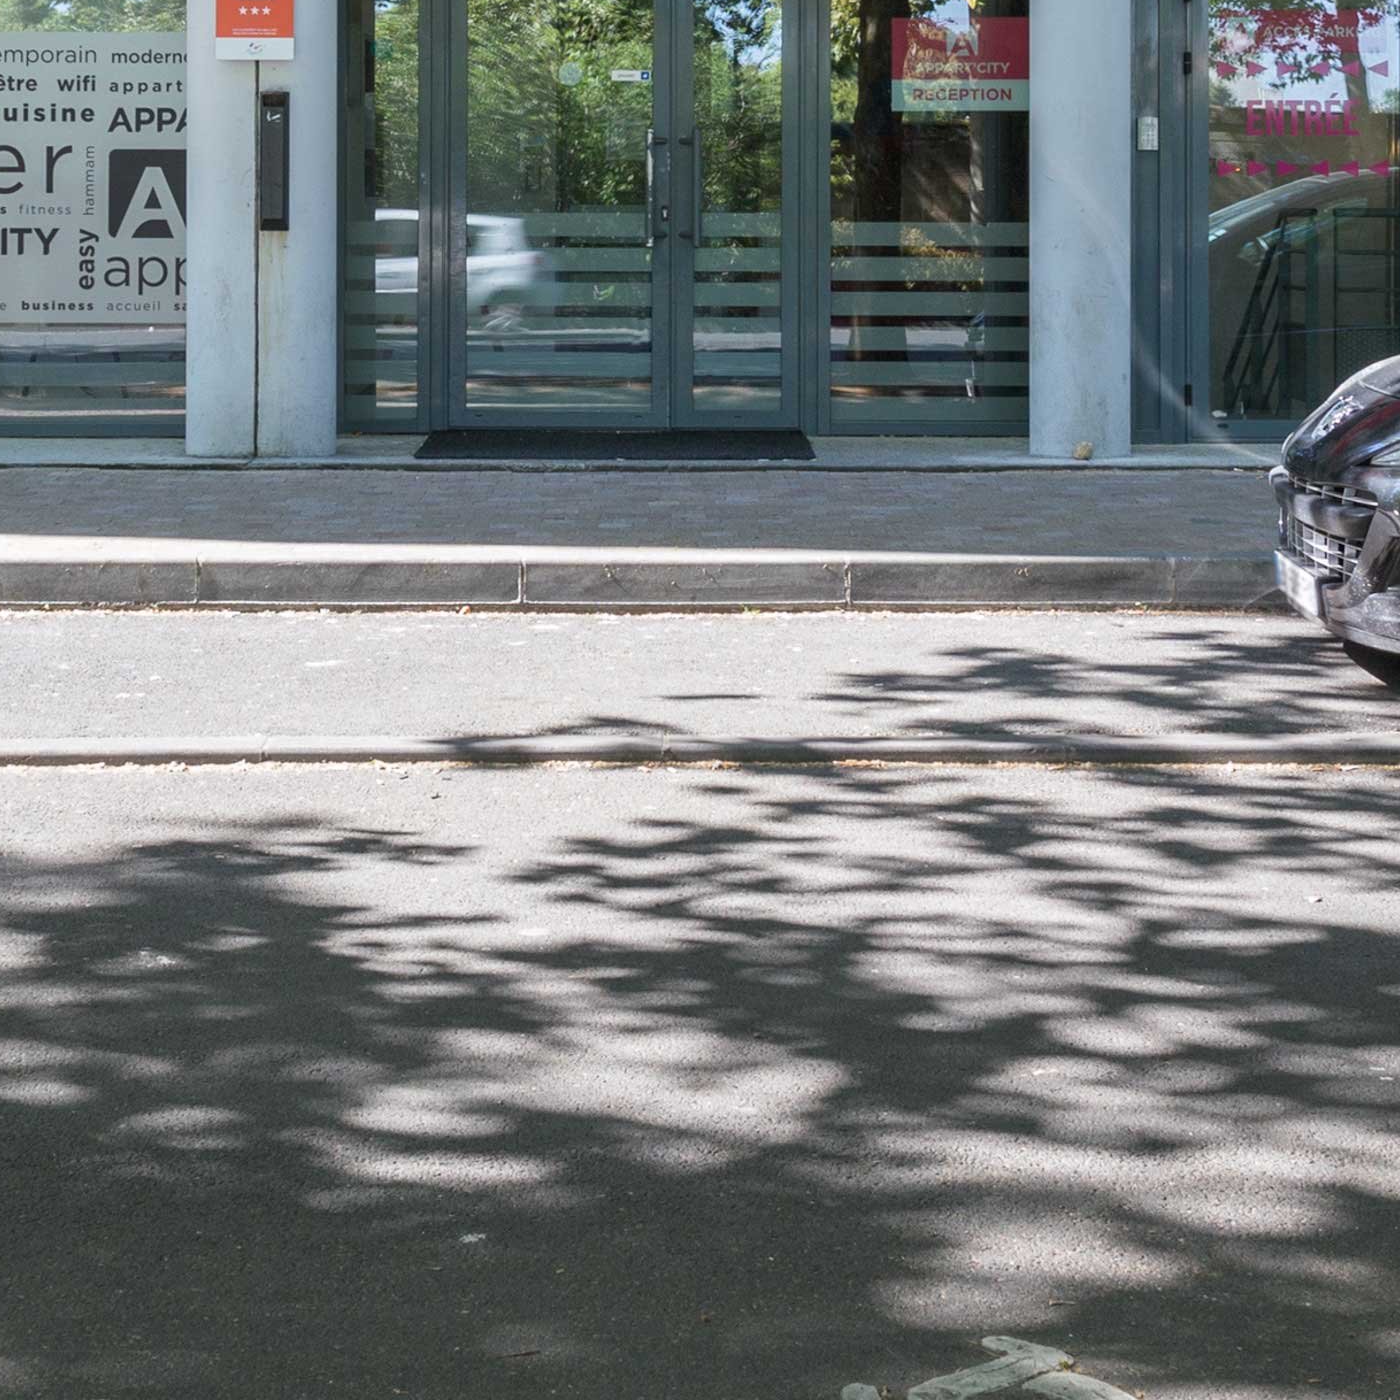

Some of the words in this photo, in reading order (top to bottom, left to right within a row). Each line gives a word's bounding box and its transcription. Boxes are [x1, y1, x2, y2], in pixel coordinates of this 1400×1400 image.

[915, 61, 1011, 74] APPART'CITY
[57, 75, 96, 92] wifi
[913, 87, 1013, 101] RECEPTION
[1246, 92, 1360, 136] ENTRÉE
[82, 145, 96, 216] hammam
[19, 204, 72, 215] fitness
[79, 229, 99, 290] easy
[21, 300, 94, 311] business
[106, 301, 161, 312] accueil
